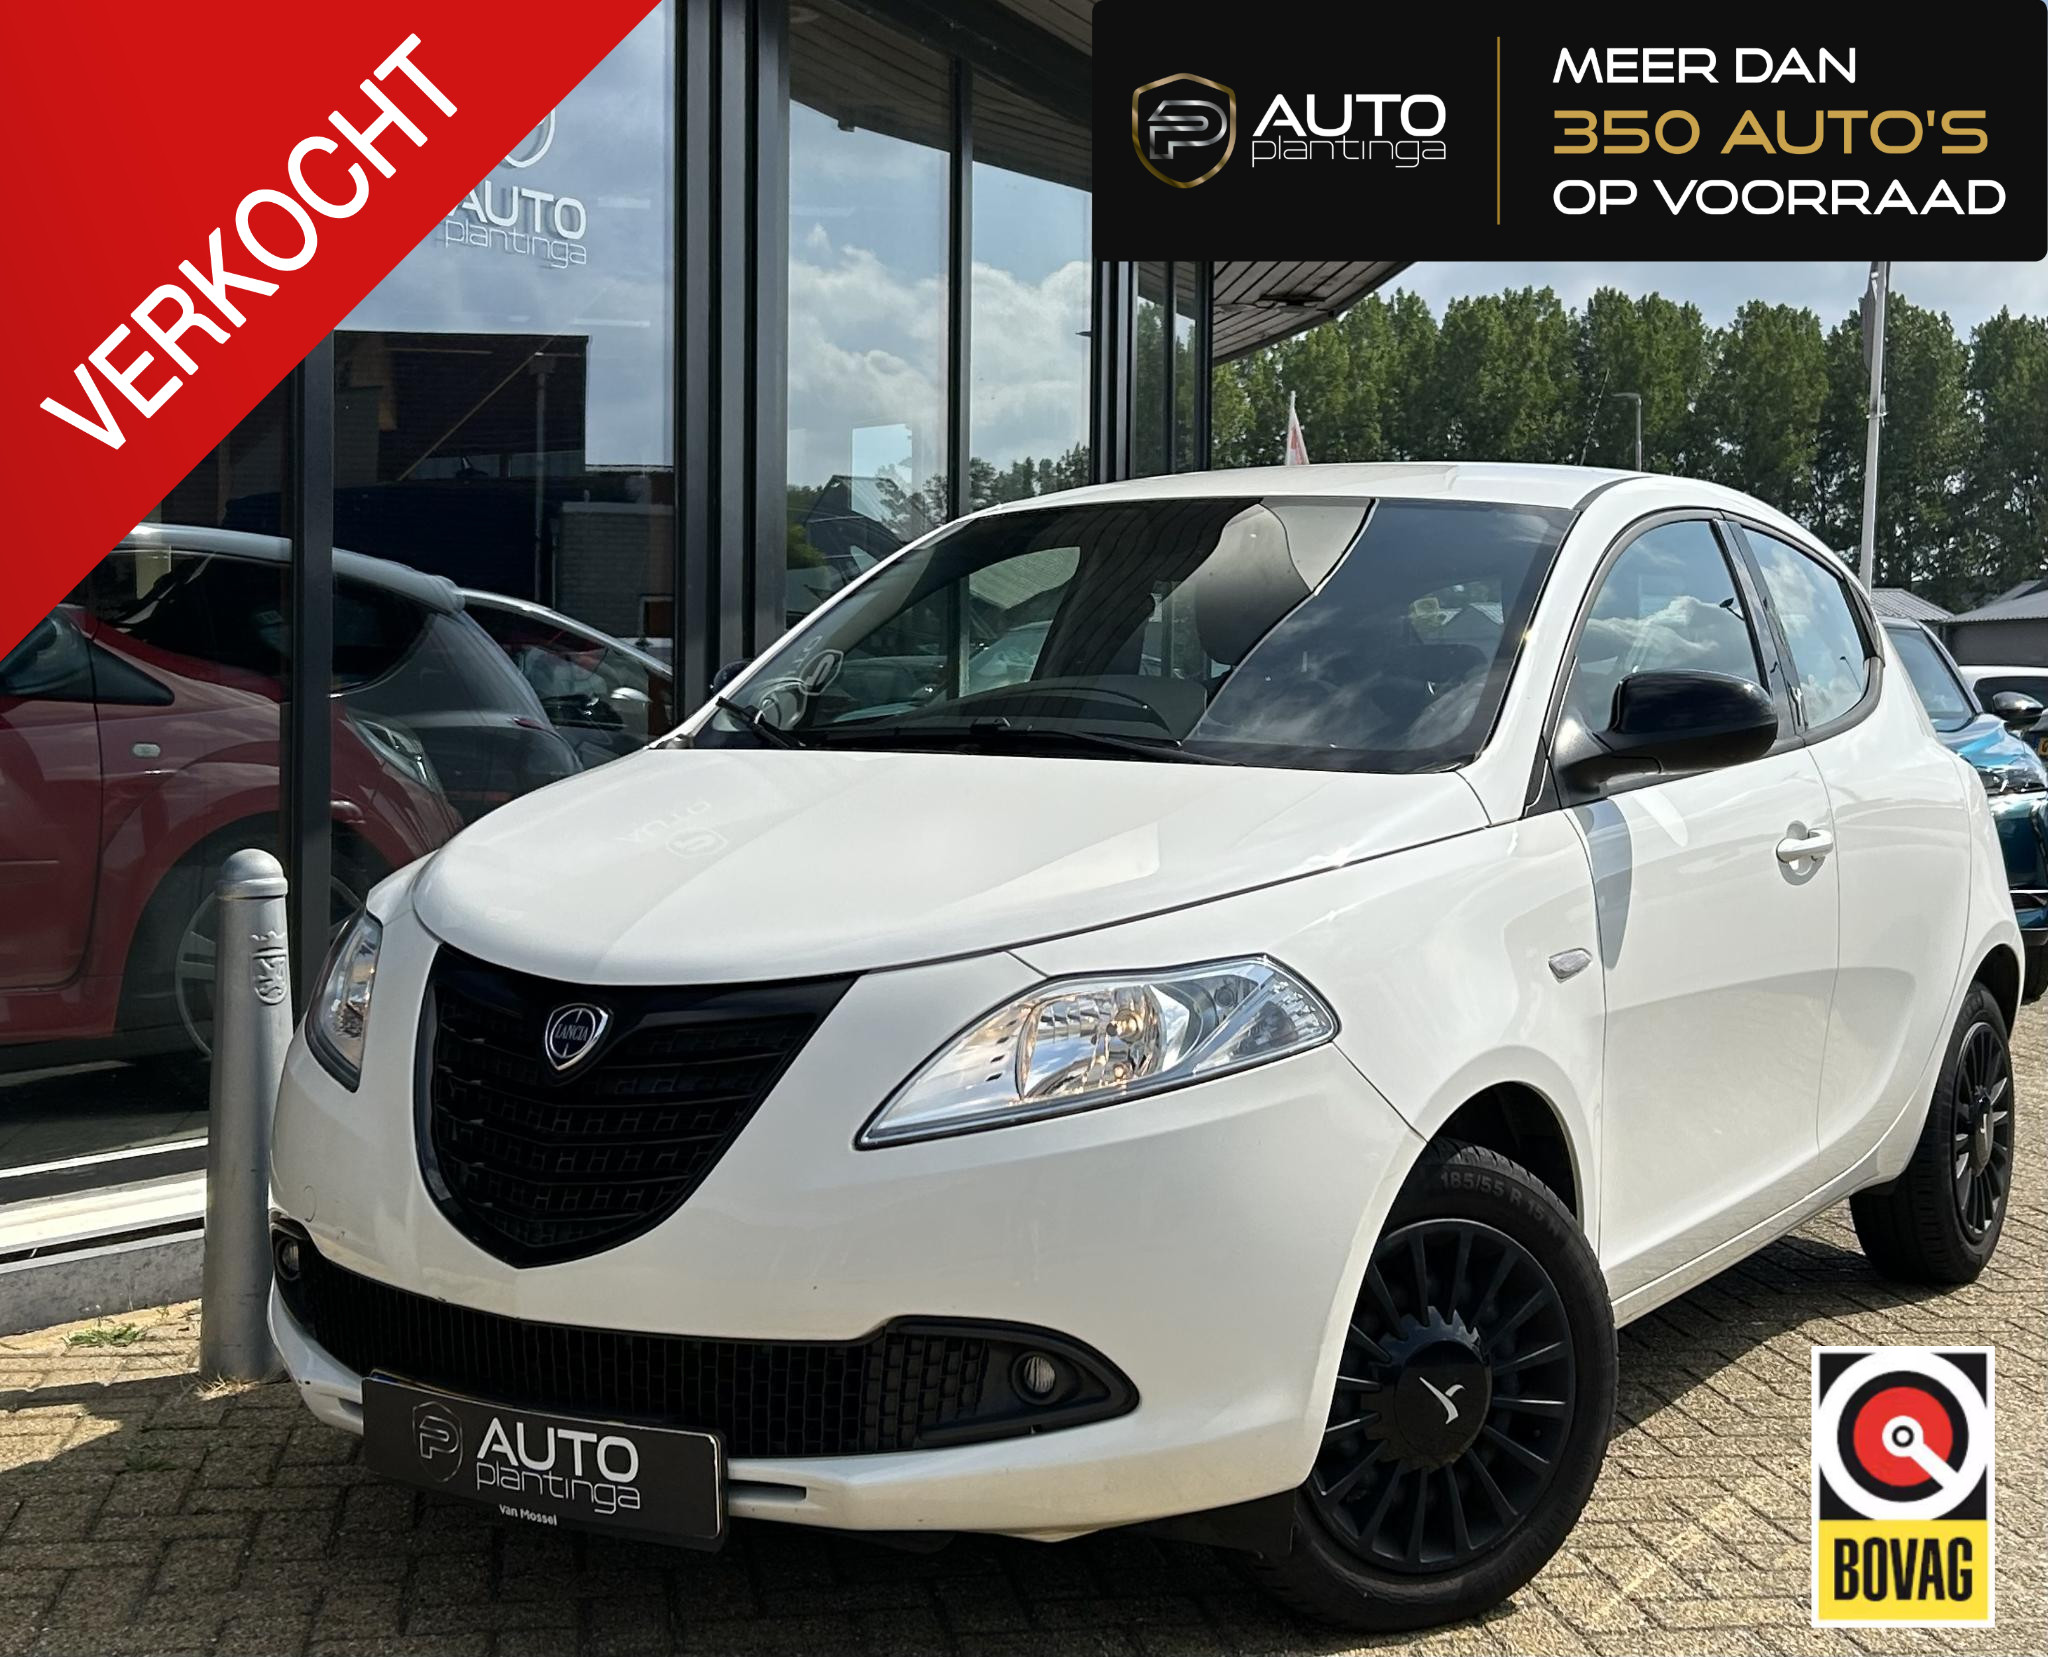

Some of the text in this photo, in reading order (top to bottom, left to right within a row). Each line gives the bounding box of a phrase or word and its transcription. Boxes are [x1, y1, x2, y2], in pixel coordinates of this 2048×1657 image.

[445, 219, 587, 269] plantinga
[554, 1023, 589, 1042] LANCIA
[477, 1417, 640, 1483] AUTO
[476, 1460, 641, 1514] plantinga
[499, 1504, 558, 1526] Van Mossel
